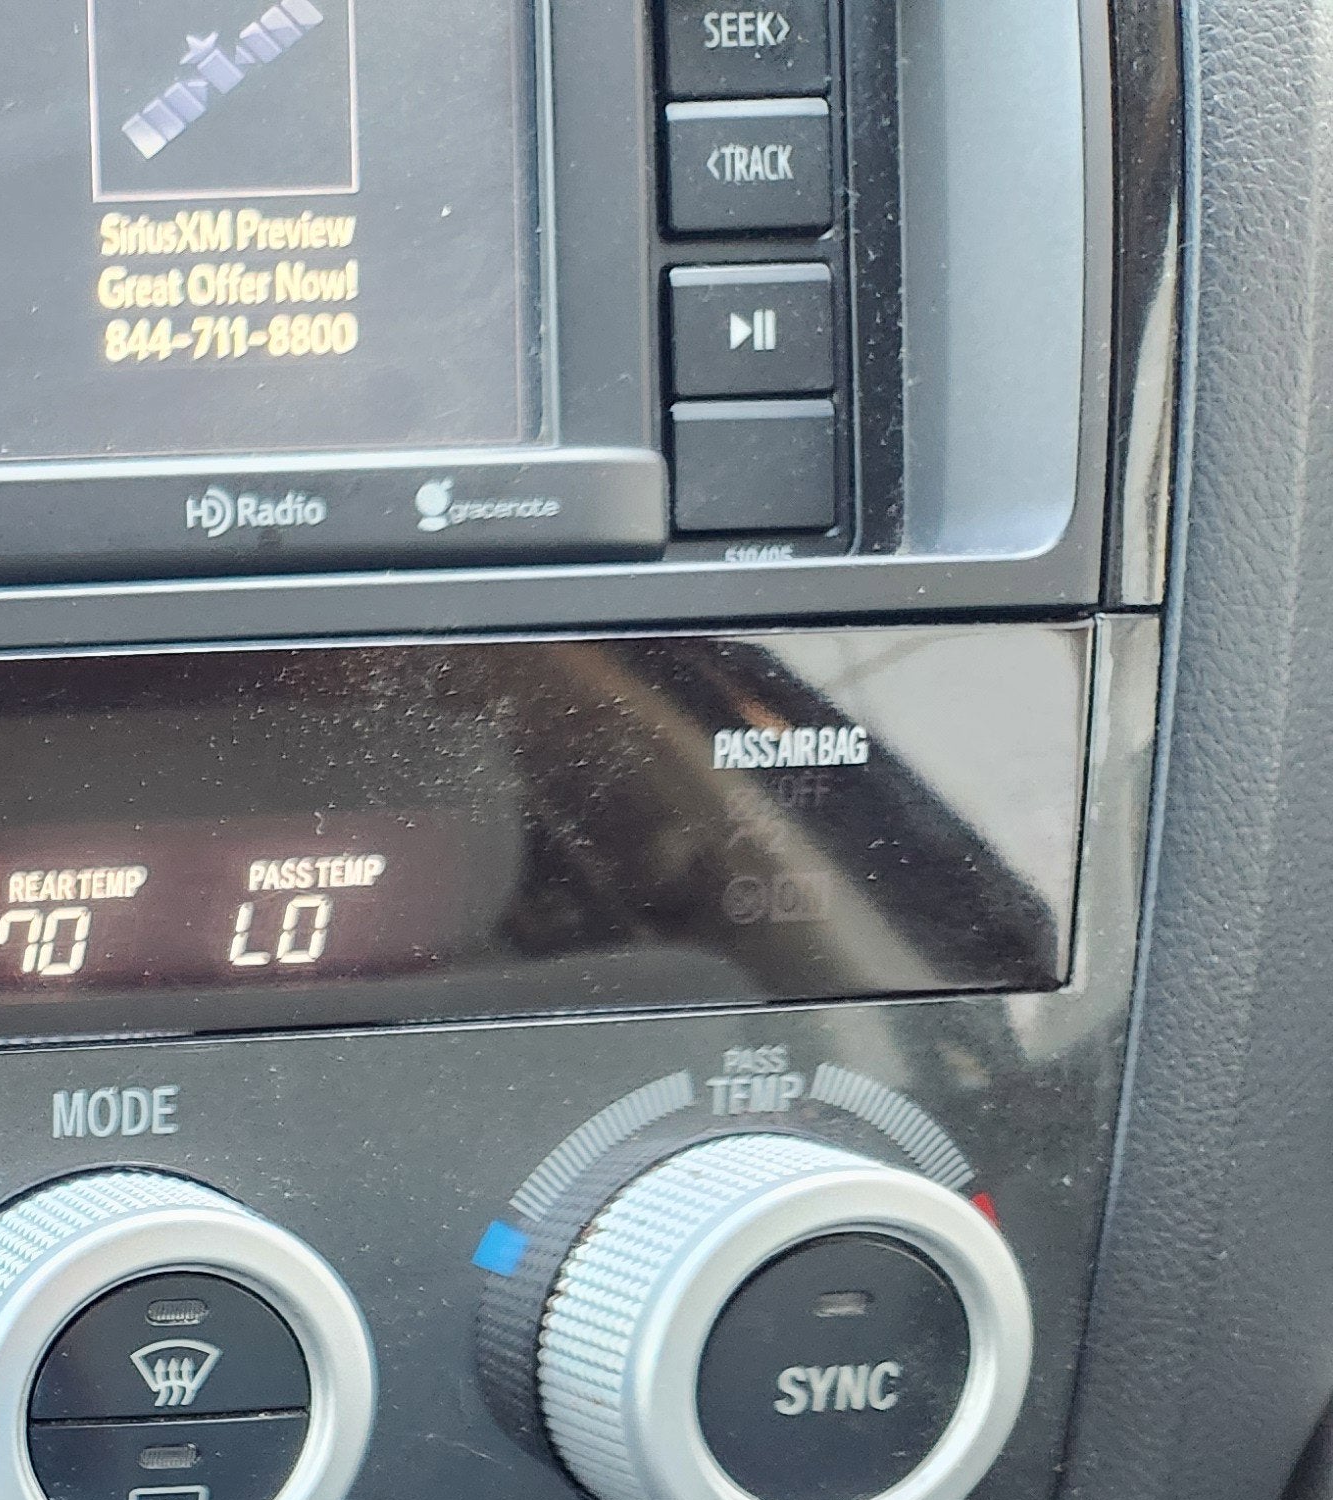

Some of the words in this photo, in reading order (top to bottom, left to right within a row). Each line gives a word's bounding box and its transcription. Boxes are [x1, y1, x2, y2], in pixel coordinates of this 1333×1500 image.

[99, 209, 231, 257] SiriusXM
[235, 209, 357, 252] Preview
[97, 264, 183, 310] Great
[187, 262, 270, 307] Offer
[274, 260, 359, 304] Now!
[104, 312, 359, 364] 844-711-8800
[236, 494, 327, 527] Radio
[446, 496, 562, 523] gracenote
[9, 870, 75, 902] REAR
[75, 865, 148, 899] TEMP
[249, 858, 315, 891] PASS
[315, 855, 386, 886] TEMP
[722, 1046, 789, 1072] PASS
[52, 1085, 179, 1139] MODE
[706, 1073, 806, 1115] TEMP
[773, 1361, 902, 1416] SYNC
